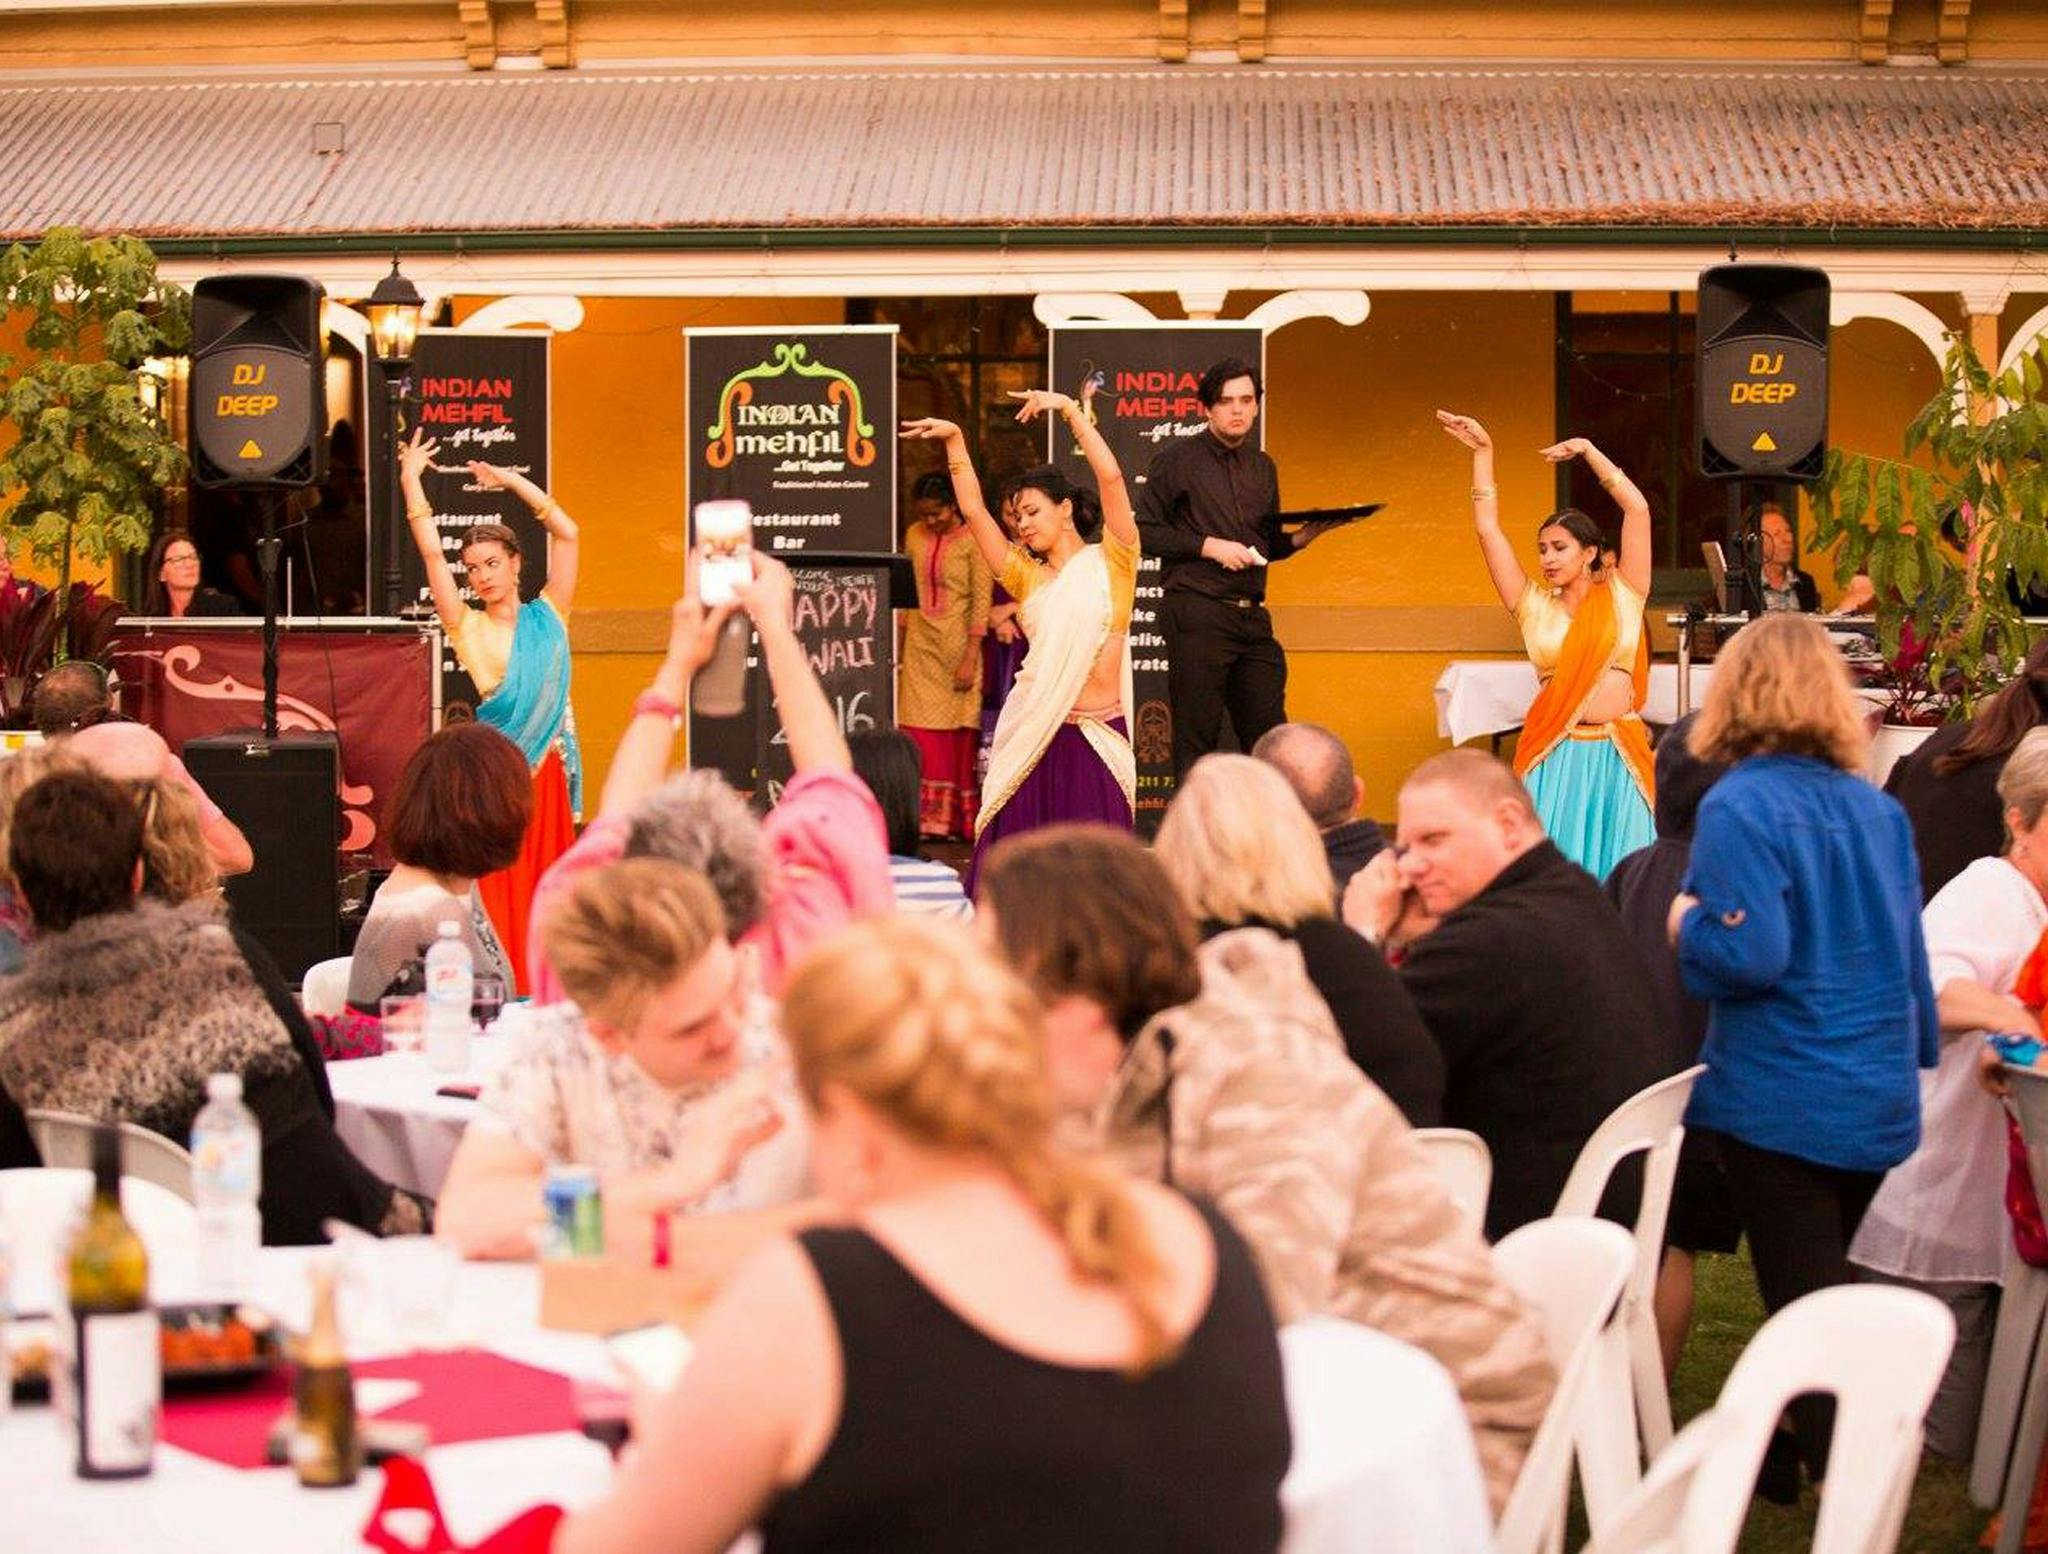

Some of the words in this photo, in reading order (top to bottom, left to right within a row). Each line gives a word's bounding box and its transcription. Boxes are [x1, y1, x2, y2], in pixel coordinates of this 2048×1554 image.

[1749, 354, 1784, 374] DJ
[233, 364, 265, 385] DJ
[1116, 372, 1205, 391] INDIA
[422, 379, 512, 397] INDIAN
[1730, 383, 1797, 404] DEEP
[216, 395, 278, 417] DEEP
[422, 404, 513, 423] MEHFIL
[737, 405, 840, 425] INDIAN
[1116, 398, 1205, 416] MEHFI
[736, 431, 843, 457] mehfil
[434, 513, 502, 526] staurant
[753, 513, 841, 526] estaurant
[442, 537, 464, 550] Ba
[773, 536, 806, 550] Bar
[793, 587, 877, 632] APPY
[800, 637, 875, 675] WALI
[1133, 658, 1169, 671] rate
